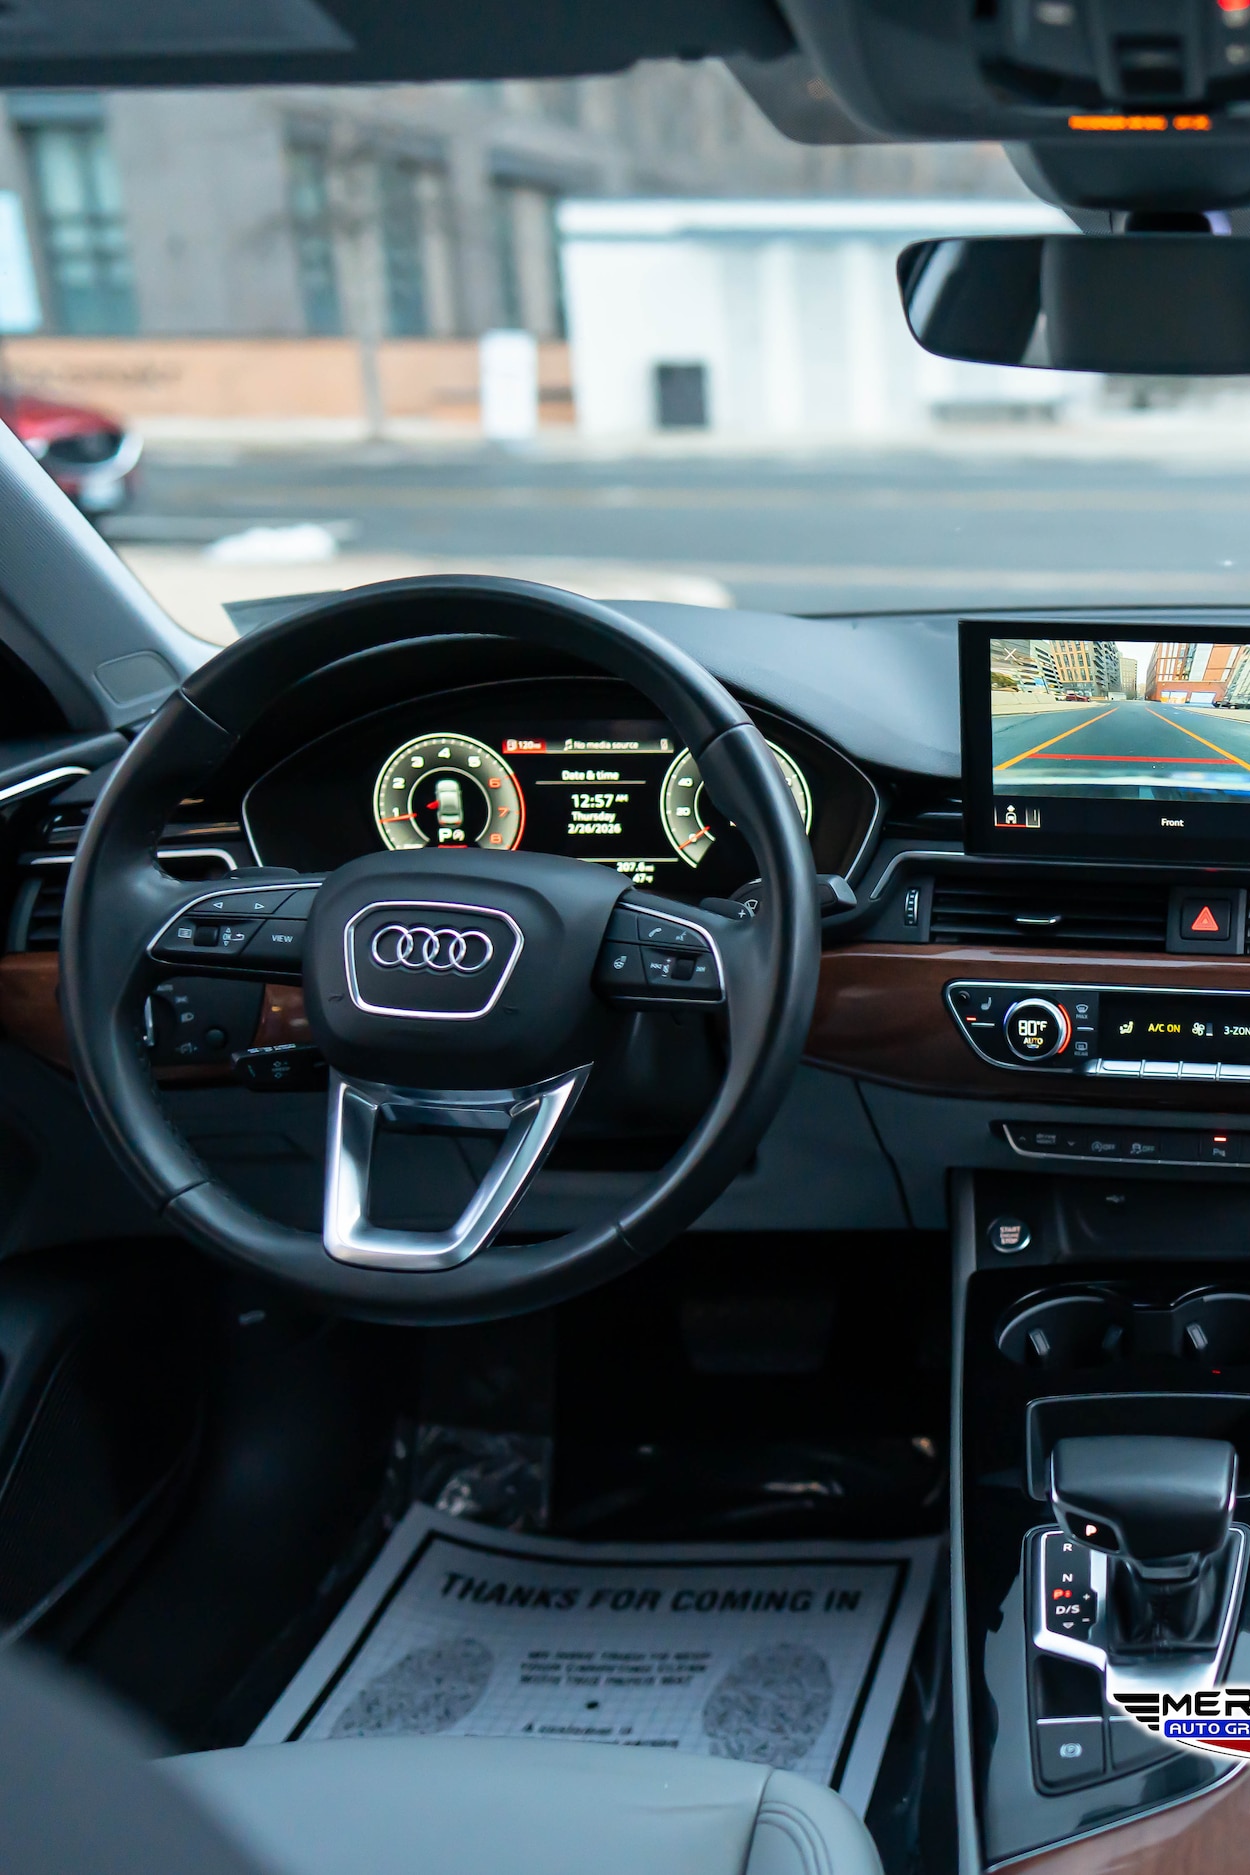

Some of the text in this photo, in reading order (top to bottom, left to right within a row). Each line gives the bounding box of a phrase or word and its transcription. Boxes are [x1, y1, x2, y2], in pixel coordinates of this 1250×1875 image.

[574, 741, 587, 749] No
[589, 741, 611, 749] media
[438, 747, 450, 758] 4
[411, 756, 424, 768] 3
[468, 756, 481, 767] 5
[562, 771, 619, 780] Date & time
[392, 777, 405, 789] 2
[488, 778, 501, 788] 6
[678, 778, 693, 787] 40
[571, 794, 629, 808] 12:57 AM
[498, 806, 509, 817] 7
[571, 811, 616, 823] Thursday
[676, 807, 691, 816] 20
[1161, 817, 1185, 827] Front
[568, 824, 622, 834] 2/26/2026
[490, 833, 502, 844] 8
[272, 934, 293, 943] VIEW
[1018, 1020, 1048, 1036] 80°F
[1148, 1023, 1181, 1034] A/C ON
[1023, 1036, 1044, 1045] AUTO
[1085, 1524, 1097, 1536] P
[1063, 1543, 1073, 1552] R
[1062, 1573, 1073, 1583] N
[440, 1571, 862, 1613] THANKS FOR COMING IN
[1055, 1604, 1080, 1615] D/S
